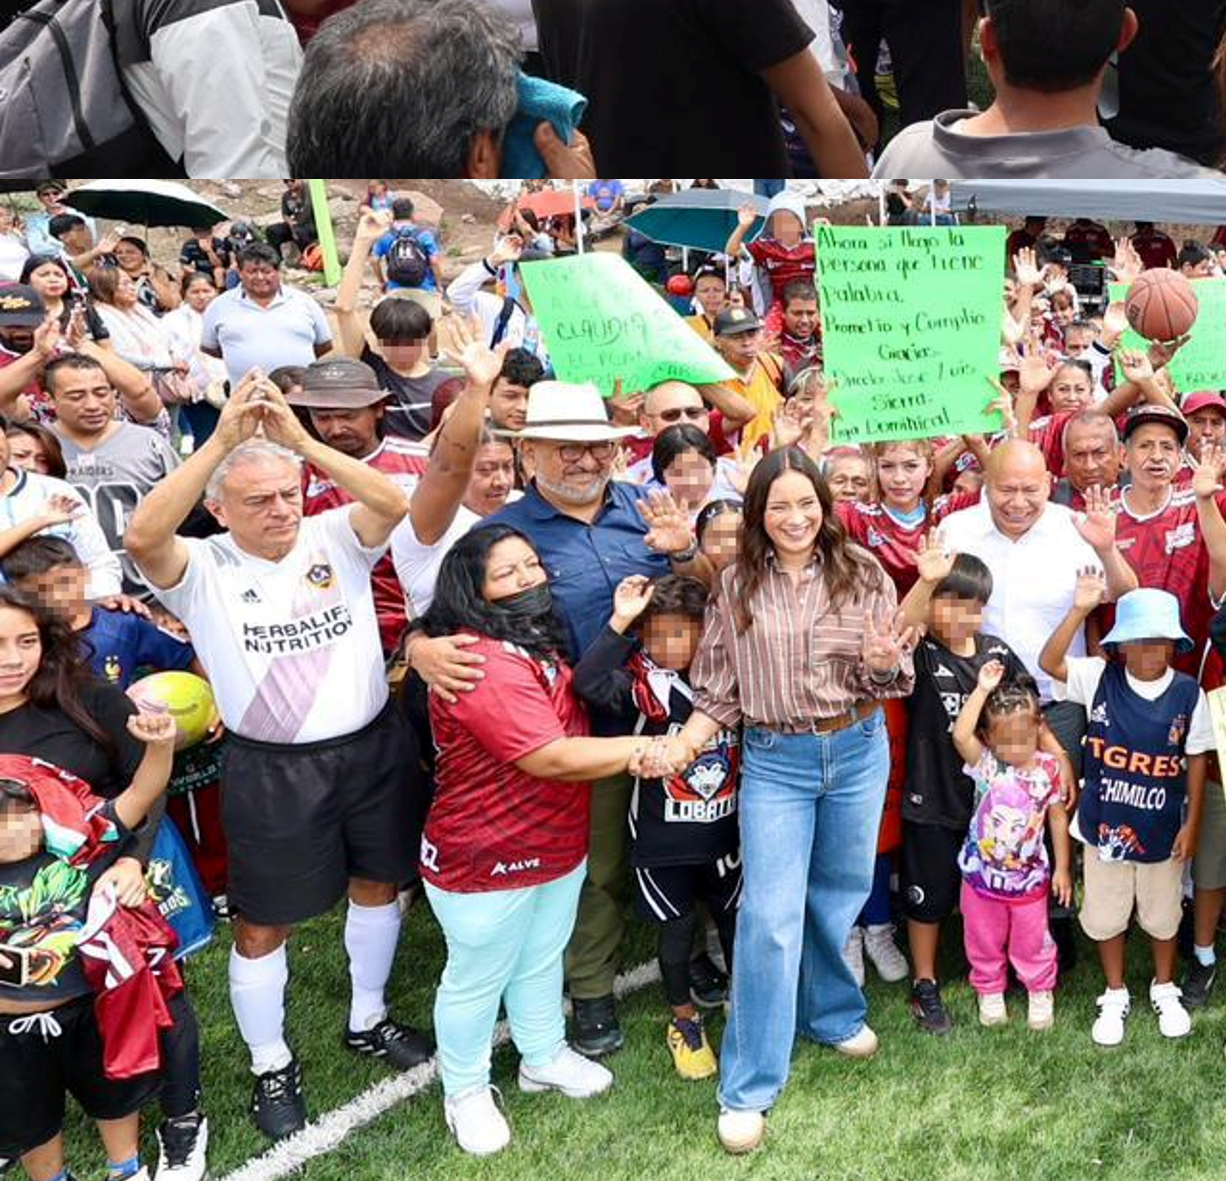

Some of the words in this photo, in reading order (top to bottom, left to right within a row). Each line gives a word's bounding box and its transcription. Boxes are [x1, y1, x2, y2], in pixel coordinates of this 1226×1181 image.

[817, 226, 867, 249] Ahora
[948, 228, 965, 246] la
[896, 256, 919, 280] que
[902, 321, 910, 336] y
[243, 605, 348, 639] HERBALIF
[507, 857, 542, 872] ALVE
